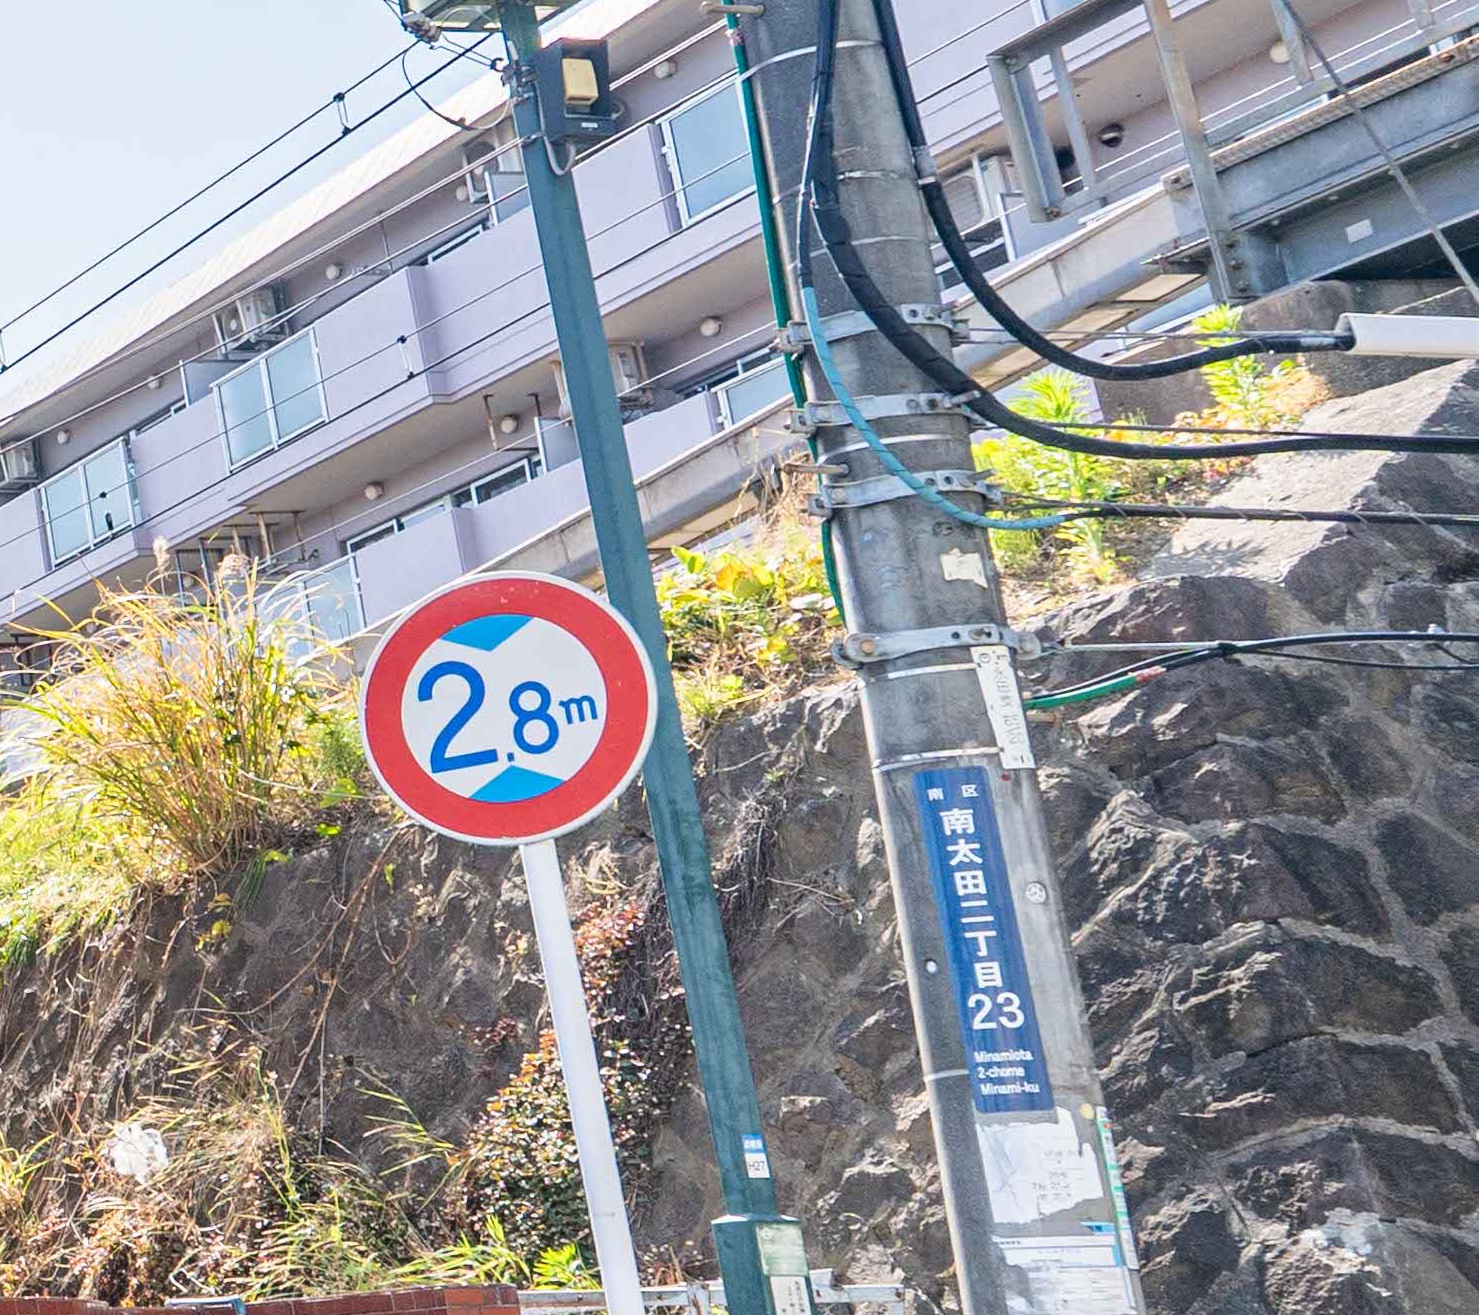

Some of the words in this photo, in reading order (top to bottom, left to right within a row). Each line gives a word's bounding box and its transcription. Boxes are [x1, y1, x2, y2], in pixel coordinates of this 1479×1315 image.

[418, 661, 598, 773] 2.8m
[927, 784, 979, 802] 南区
[940, 808, 1003, 988] 南太田二丁目
[968, 992, 1025, 1030] 23
[974, 1048, 1033, 1063] Minamiota
[977, 1064, 1025, 1079] 2-chome
[980, 1081, 1040, 1096] Minami-ku
